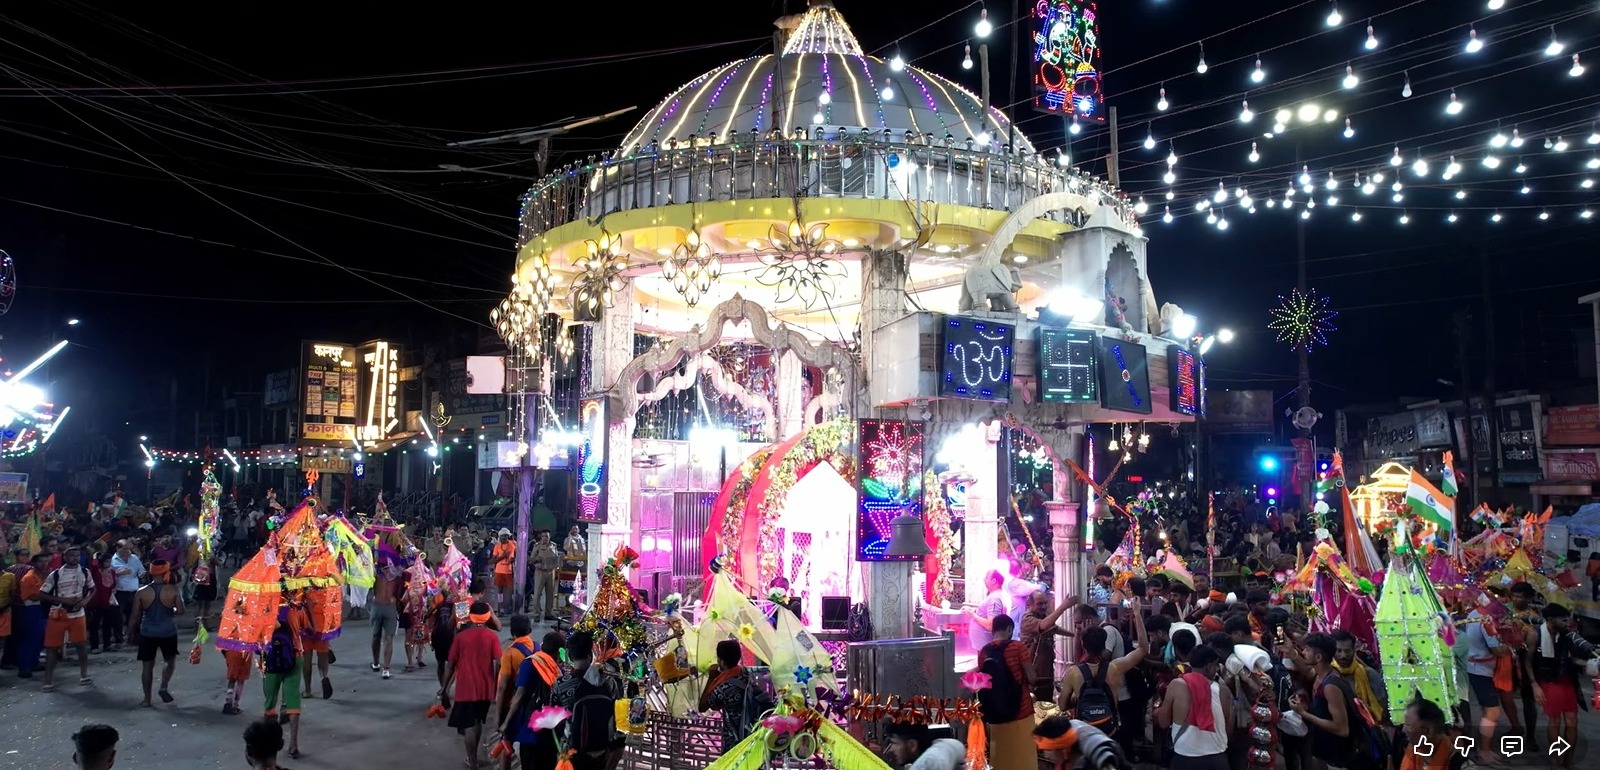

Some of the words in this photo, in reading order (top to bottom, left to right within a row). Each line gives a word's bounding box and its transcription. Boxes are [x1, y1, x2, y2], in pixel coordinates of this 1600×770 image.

[314, 344, 344, 363] कानपुर
[387, 349, 398, 418] KANPUR
[303, 459, 352, 471] KANPUR
